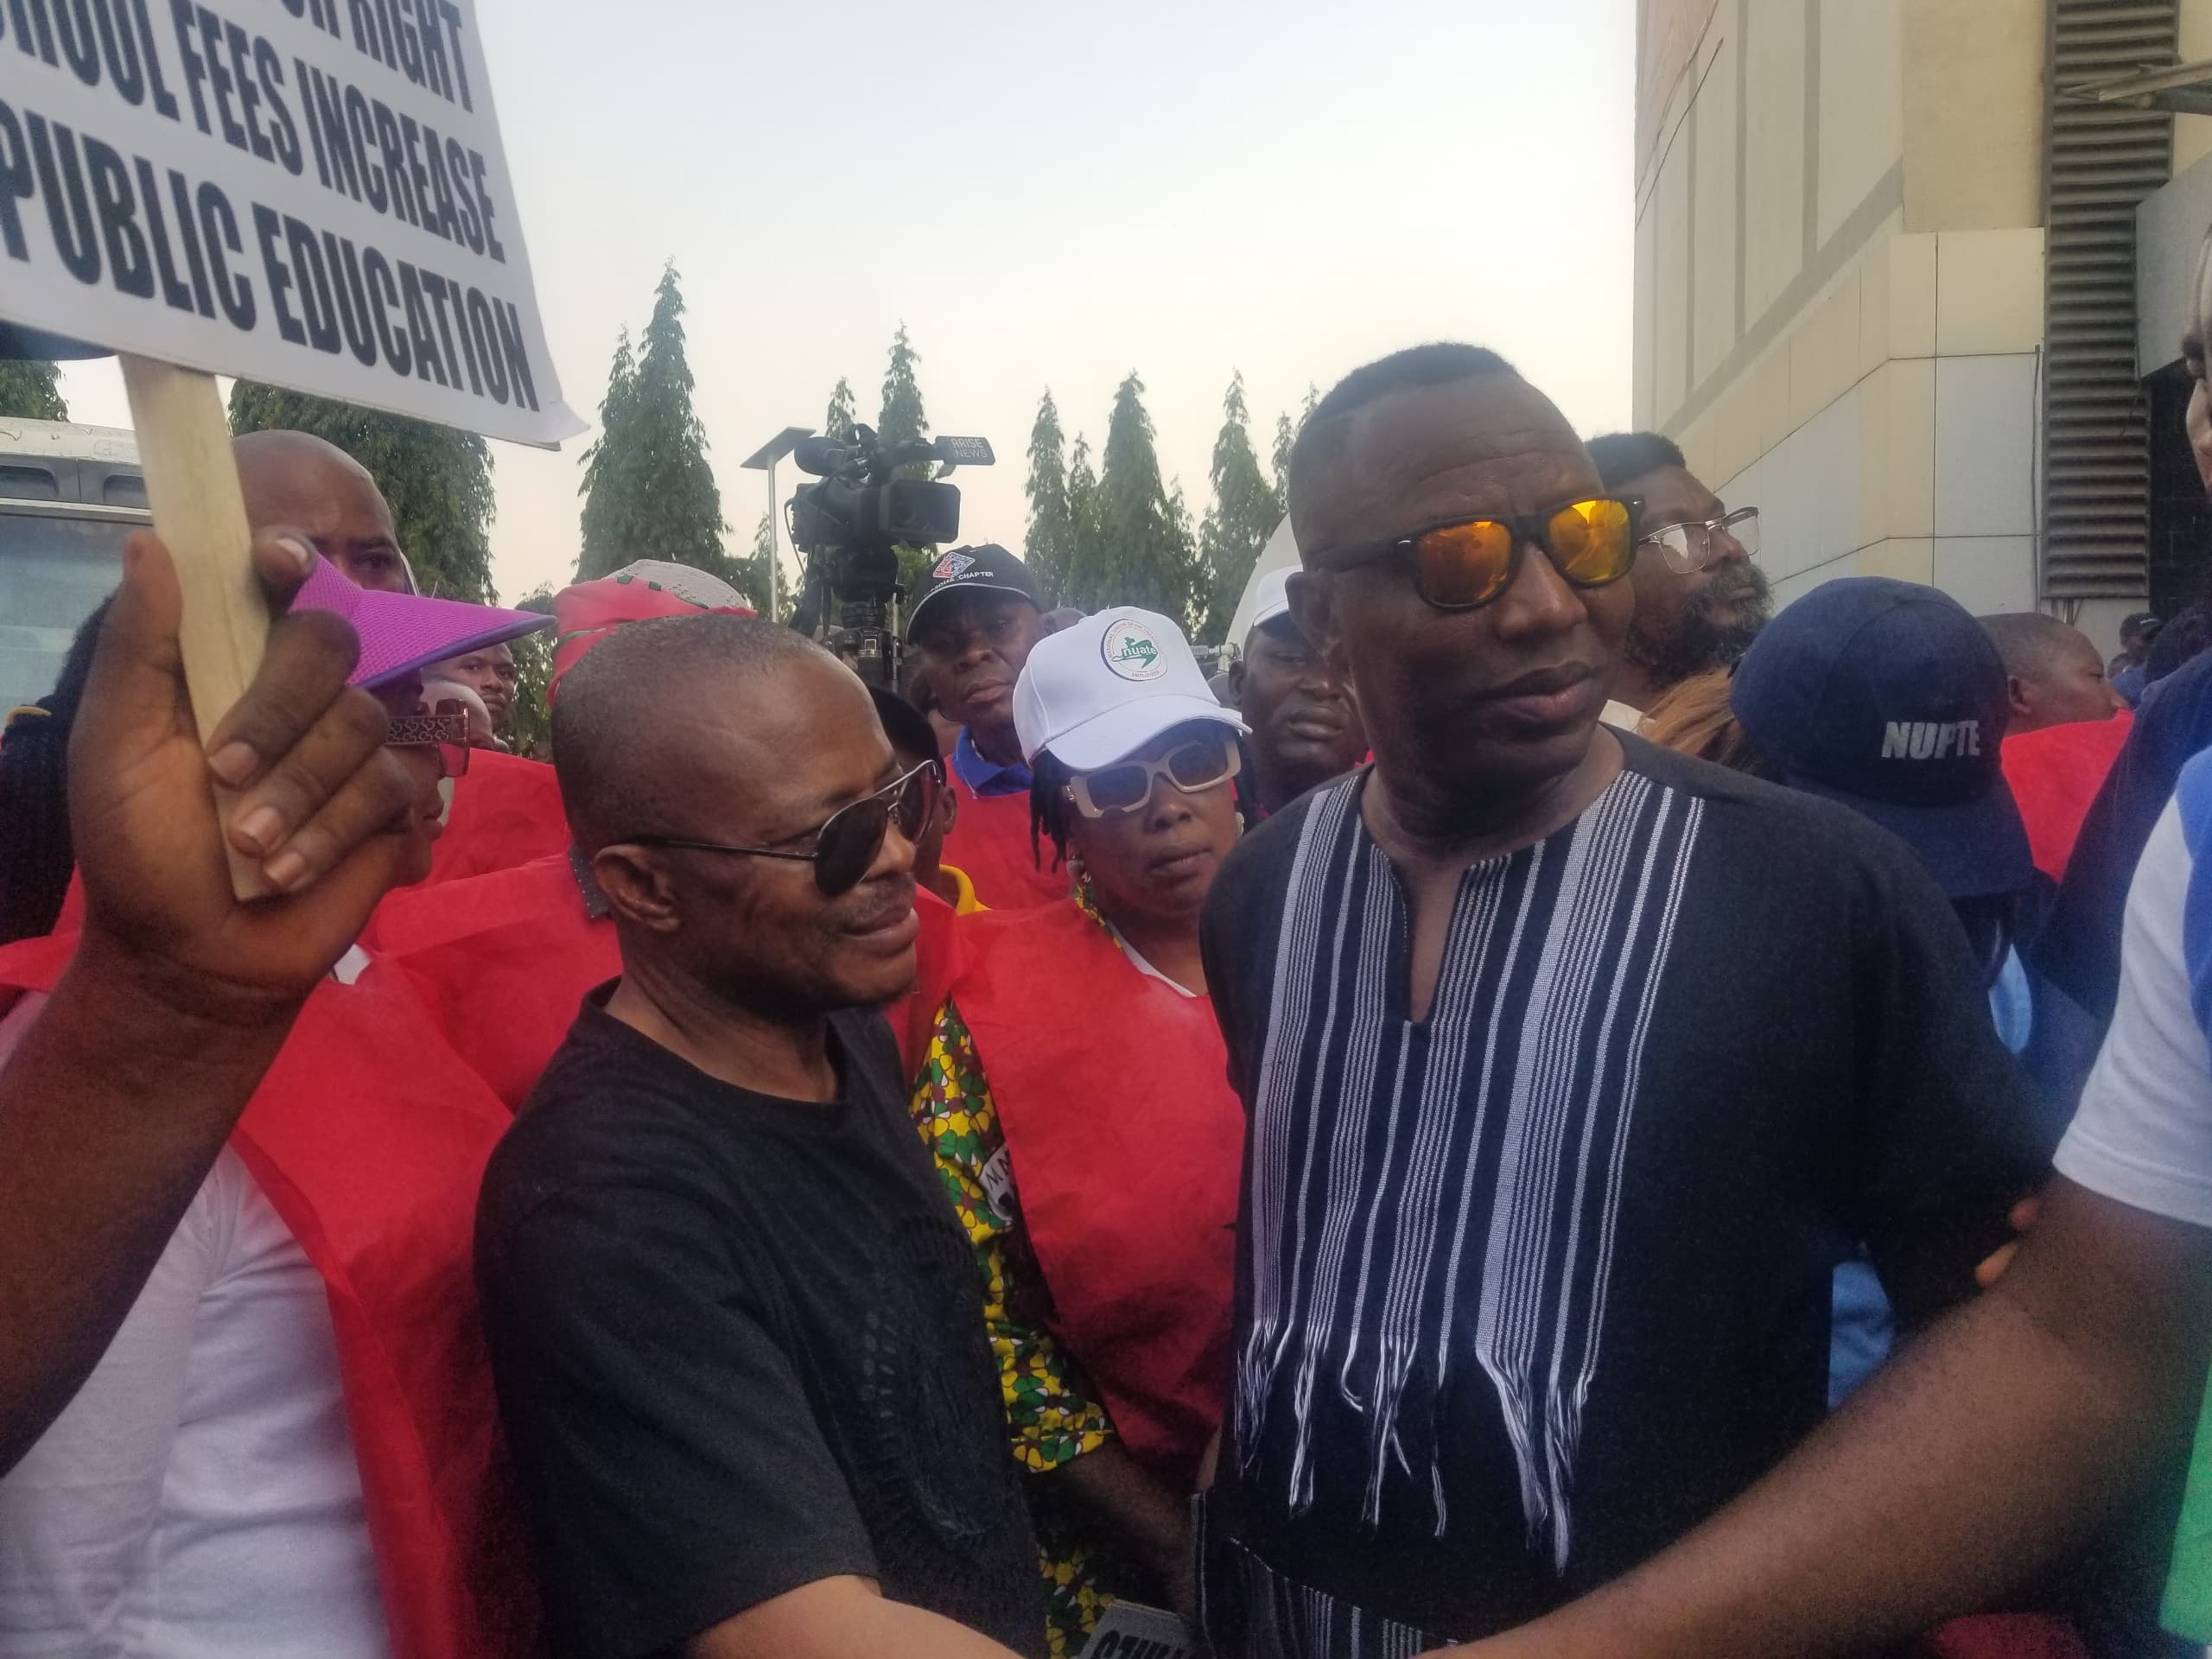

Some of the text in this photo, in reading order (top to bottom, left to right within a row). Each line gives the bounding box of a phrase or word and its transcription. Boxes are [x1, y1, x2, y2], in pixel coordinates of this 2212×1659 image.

[168, 0, 303, 175] FEES
[293, 55, 506, 264] INCREASE
[0, 97, 540, 412] PUBLIC EDUCATION
[950, 437, 983, 448] ARISE
[955, 448, 988, 457] NEWS
[1123, 645, 1157, 657] nuate
[1881, 720, 1980, 760] NUPTE
